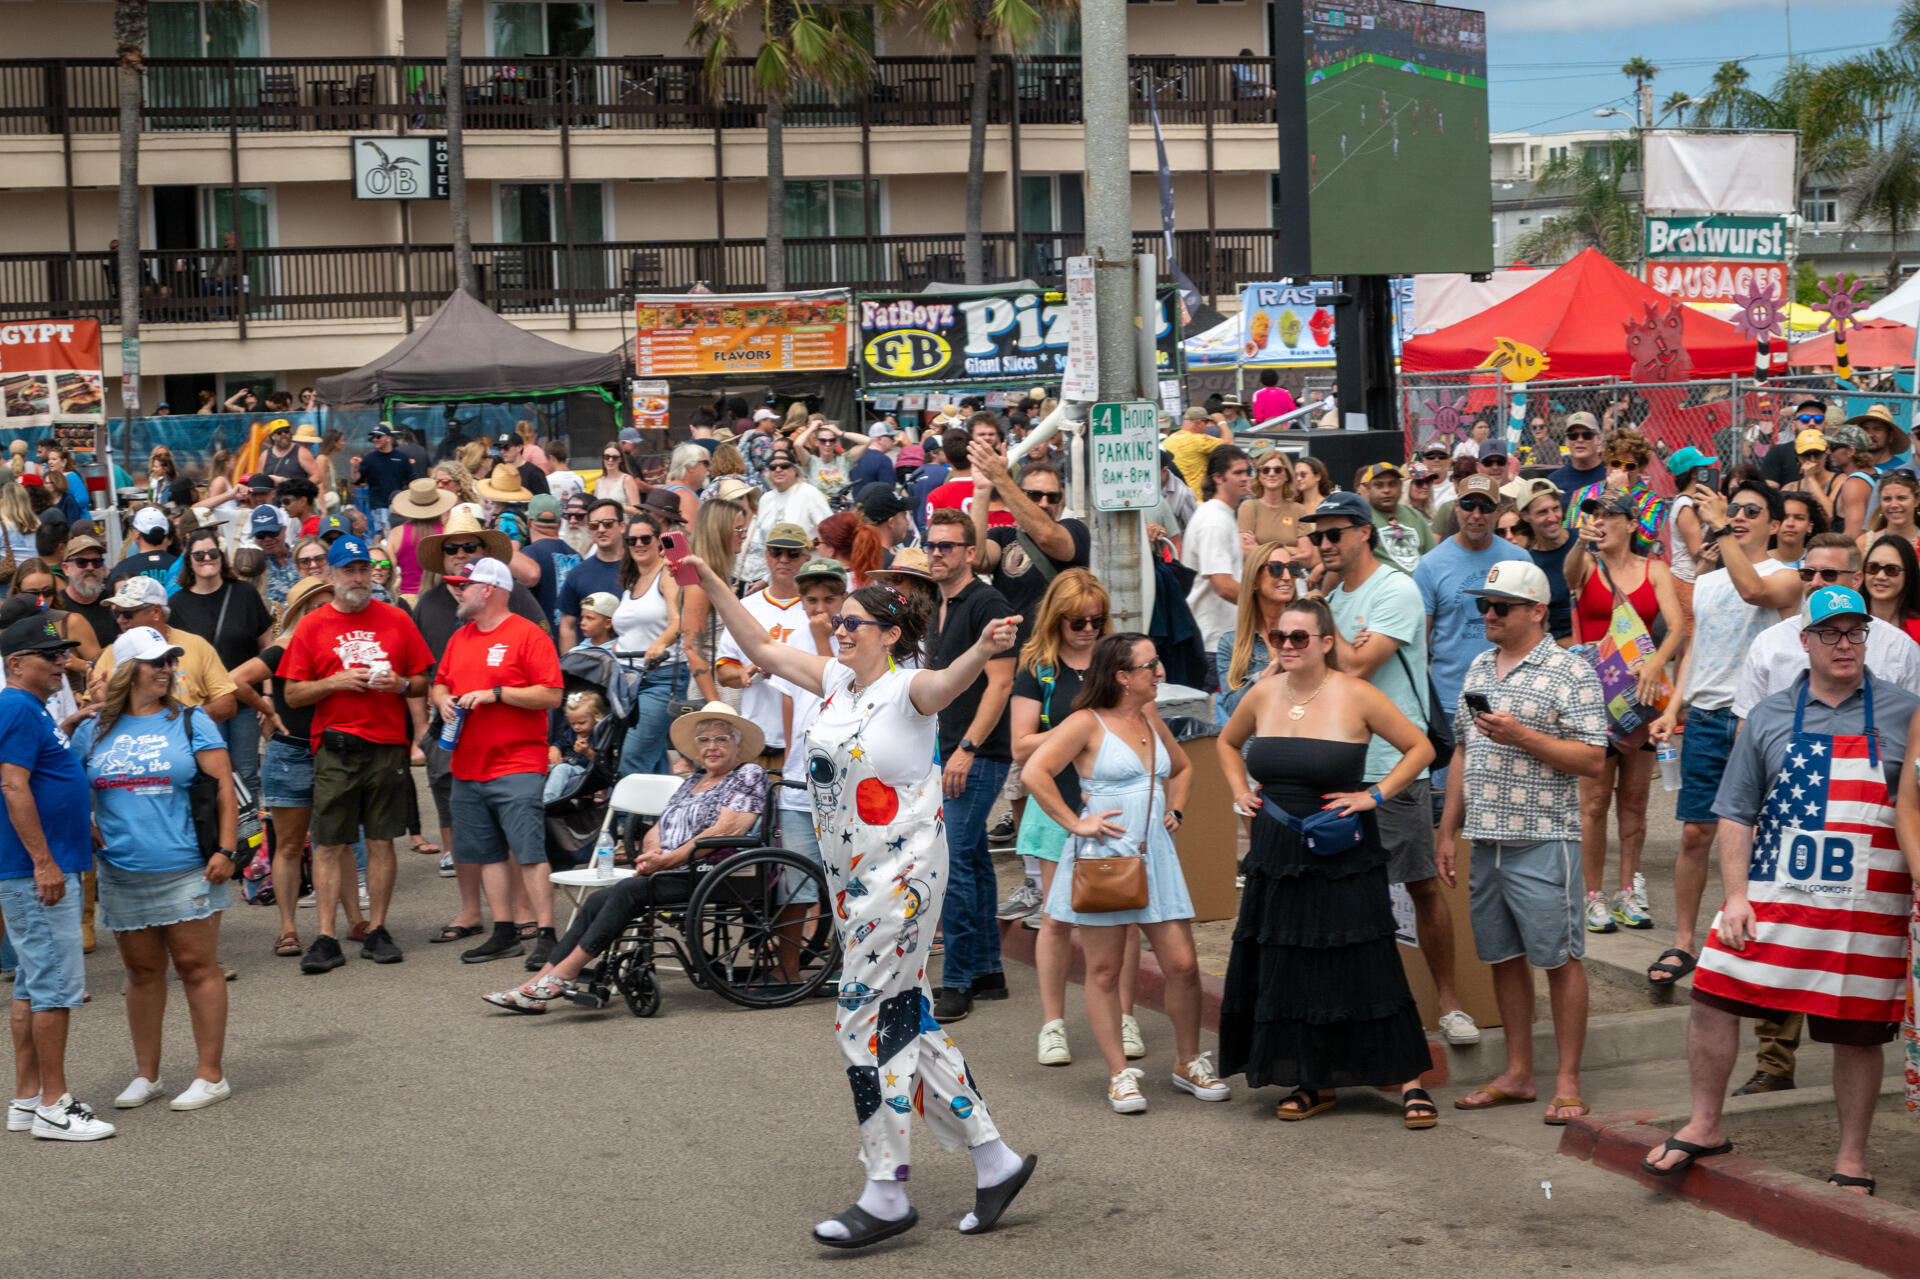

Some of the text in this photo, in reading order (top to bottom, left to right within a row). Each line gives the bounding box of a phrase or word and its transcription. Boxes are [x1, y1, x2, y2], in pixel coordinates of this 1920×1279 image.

[365, 167, 418, 195] OB
[436, 141, 448, 195] HOTEL
[1651, 221, 1782, 256] Bratwurst
[1653, 266, 1782, 301] SAUSAGES
[861, 300, 954, 331] FatBoyz
[958, 296, 1171, 358] Piz
[0, 323, 75, 346] GYPT
[713, 350, 772, 361] FLAVORS
[873, 334, 943, 374] FB
[964, 357, 1001, 375] Giant
[1003, 355, 1038, 374] Slices
[1101, 408, 1154, 433] 4 HOUR
[1098, 441, 1153, 463] PARKING
[1102, 467, 1150, 484] 8AM-8PM
[345, 630, 376, 641] LIKE
[1788, 834, 1854, 881] OB
